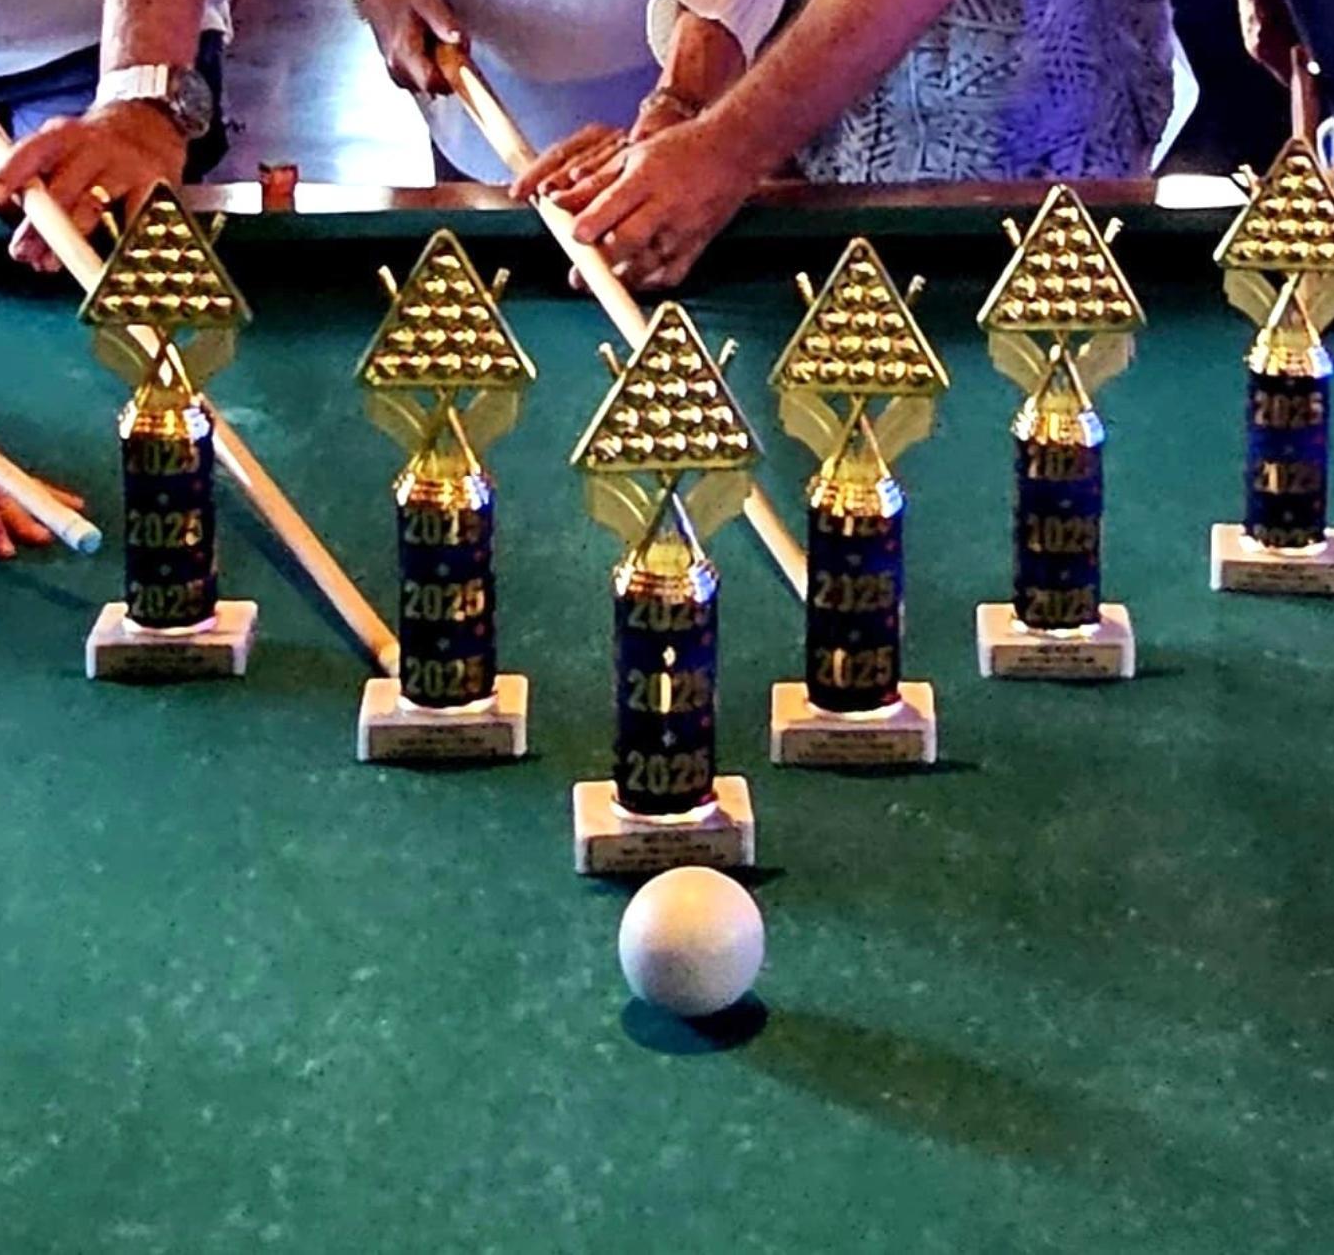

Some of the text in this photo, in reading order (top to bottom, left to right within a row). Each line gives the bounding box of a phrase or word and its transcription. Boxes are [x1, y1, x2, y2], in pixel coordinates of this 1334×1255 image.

[128, 509, 204, 547] 2025
[404, 577, 486, 621] 2025
[405, 654, 486, 696] 2025
[627, 667, 711, 713] 2025
[626, 749, 710, 794] 2025
